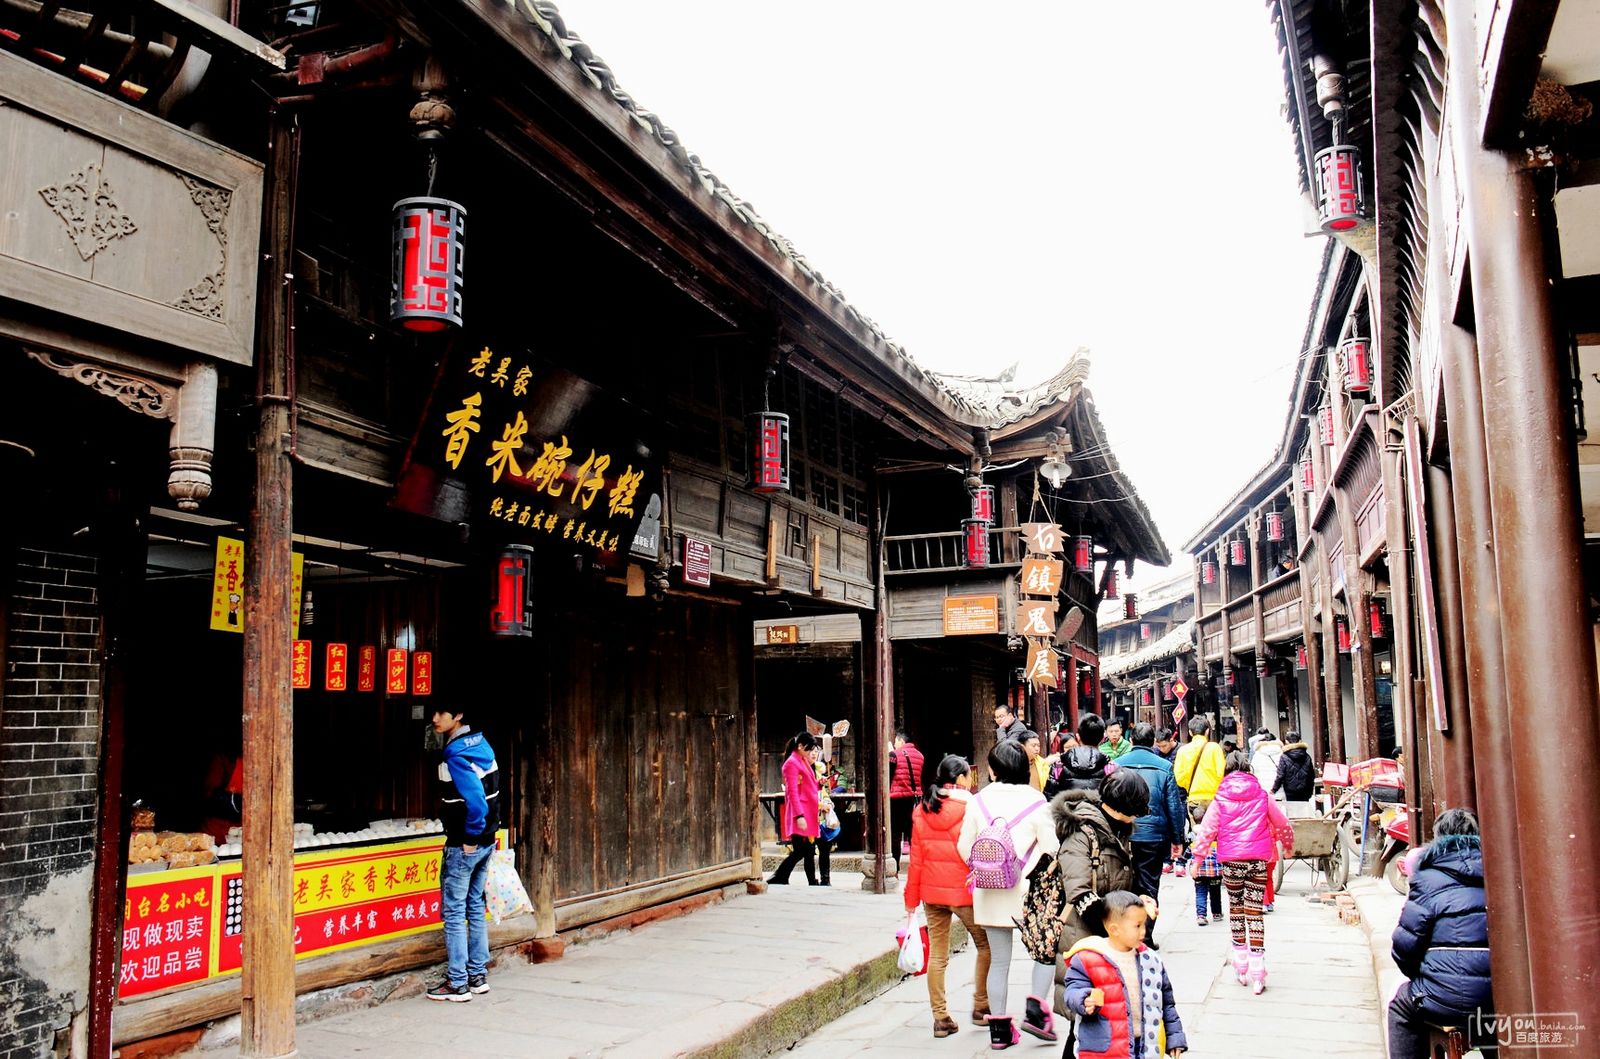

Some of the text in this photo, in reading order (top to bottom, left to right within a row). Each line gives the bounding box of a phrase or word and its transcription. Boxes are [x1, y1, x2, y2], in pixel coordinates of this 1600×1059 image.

[442, 391, 645, 519] 香米碗仔糕
[330, 646, 344, 687] 红豆味
[391, 651, 403, 690] 豆沙味
[416, 654, 428, 692] 绿豆味
[123, 915, 204, 951] 现做现卖
[323, 909, 379, 939] 营养丰富
[119, 946, 203, 985] 欢迎品尝
